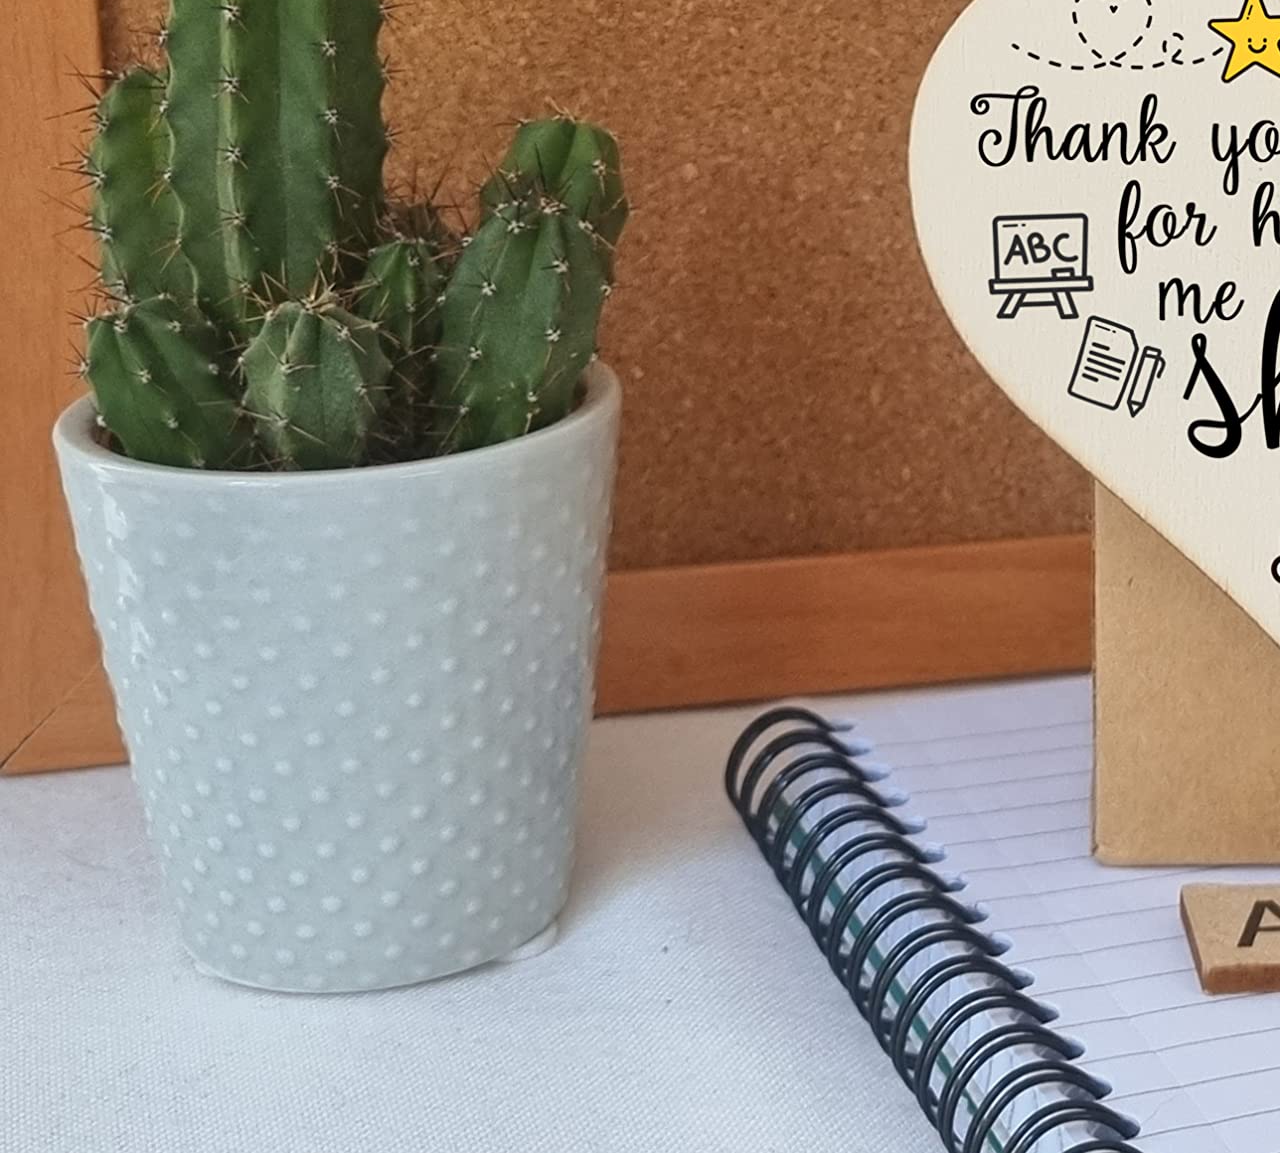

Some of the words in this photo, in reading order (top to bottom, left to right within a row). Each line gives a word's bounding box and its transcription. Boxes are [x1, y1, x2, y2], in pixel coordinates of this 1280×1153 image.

[969, 85, 1178, 168] Thank
[1003, 231, 1080, 266] ABC
[1116, 179, 1218, 274] for
[1157, 278, 1245, 324] me
